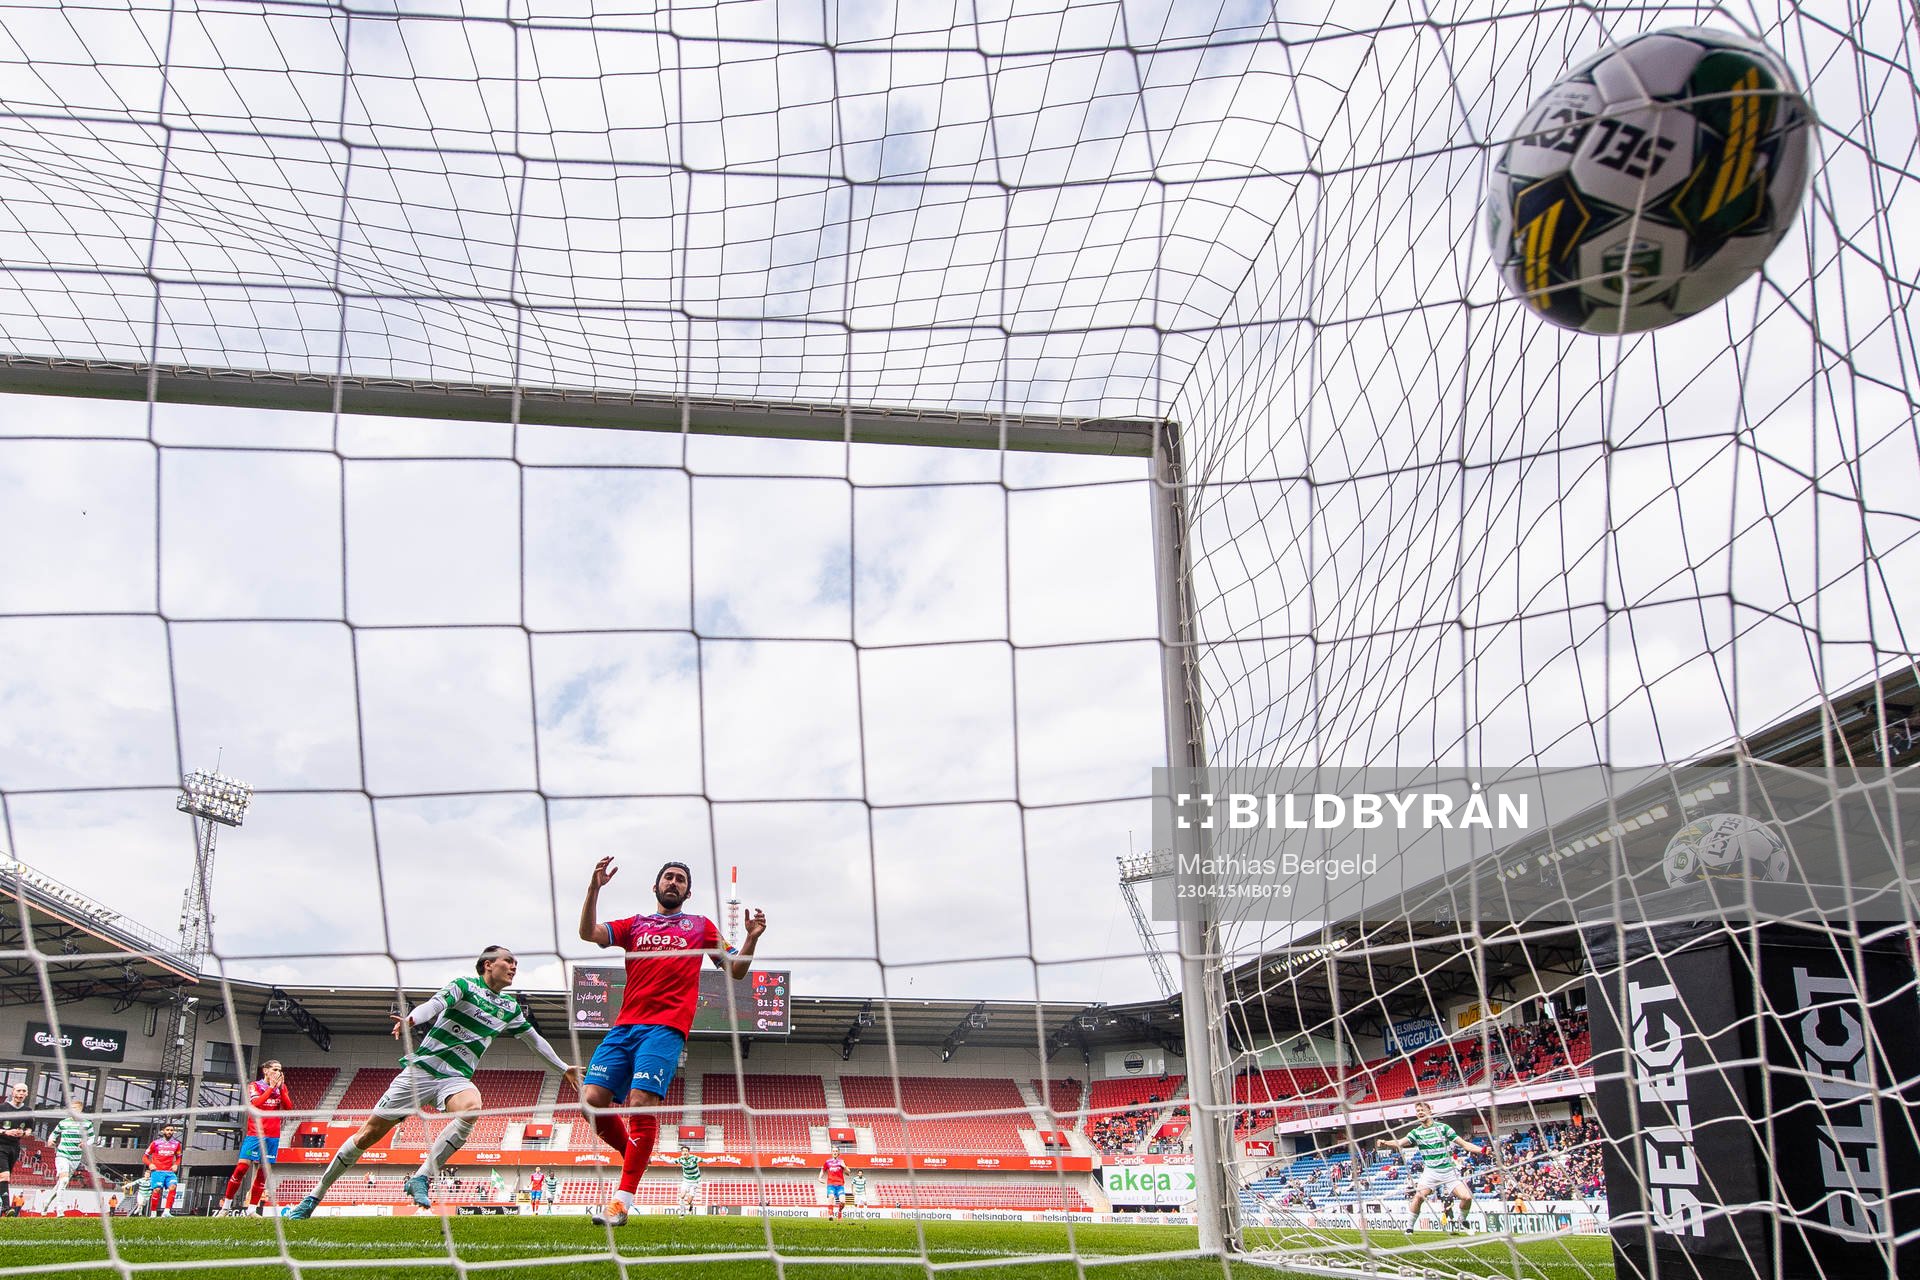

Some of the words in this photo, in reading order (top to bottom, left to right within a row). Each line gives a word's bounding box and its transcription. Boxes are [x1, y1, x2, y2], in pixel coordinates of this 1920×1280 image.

[637, 932, 671, 946] akea
[759, 975, 764, 983] 0
[778, 975, 784, 983] 0
[757, 999, 784, 1007] 81:55
[81, 1035, 118, 1052] Carlsberg
[590, 1063, 608, 1073] Solid
[1628, 980, 1705, 1238] SELECT
[1793, 966, 1890, 1243] SELECT
[1114, 1156, 1145, 1165] Scandic
[1110, 1168, 1171, 1191] akea
[212, 1209, 247, 1218] ZEGA
[891, 1211, 951, 1220] tillhelsingborg
[963, 1213, 1022, 1222] tillhelsingborg
[1033, 1214, 1092, 1223] tillhelsingborg
